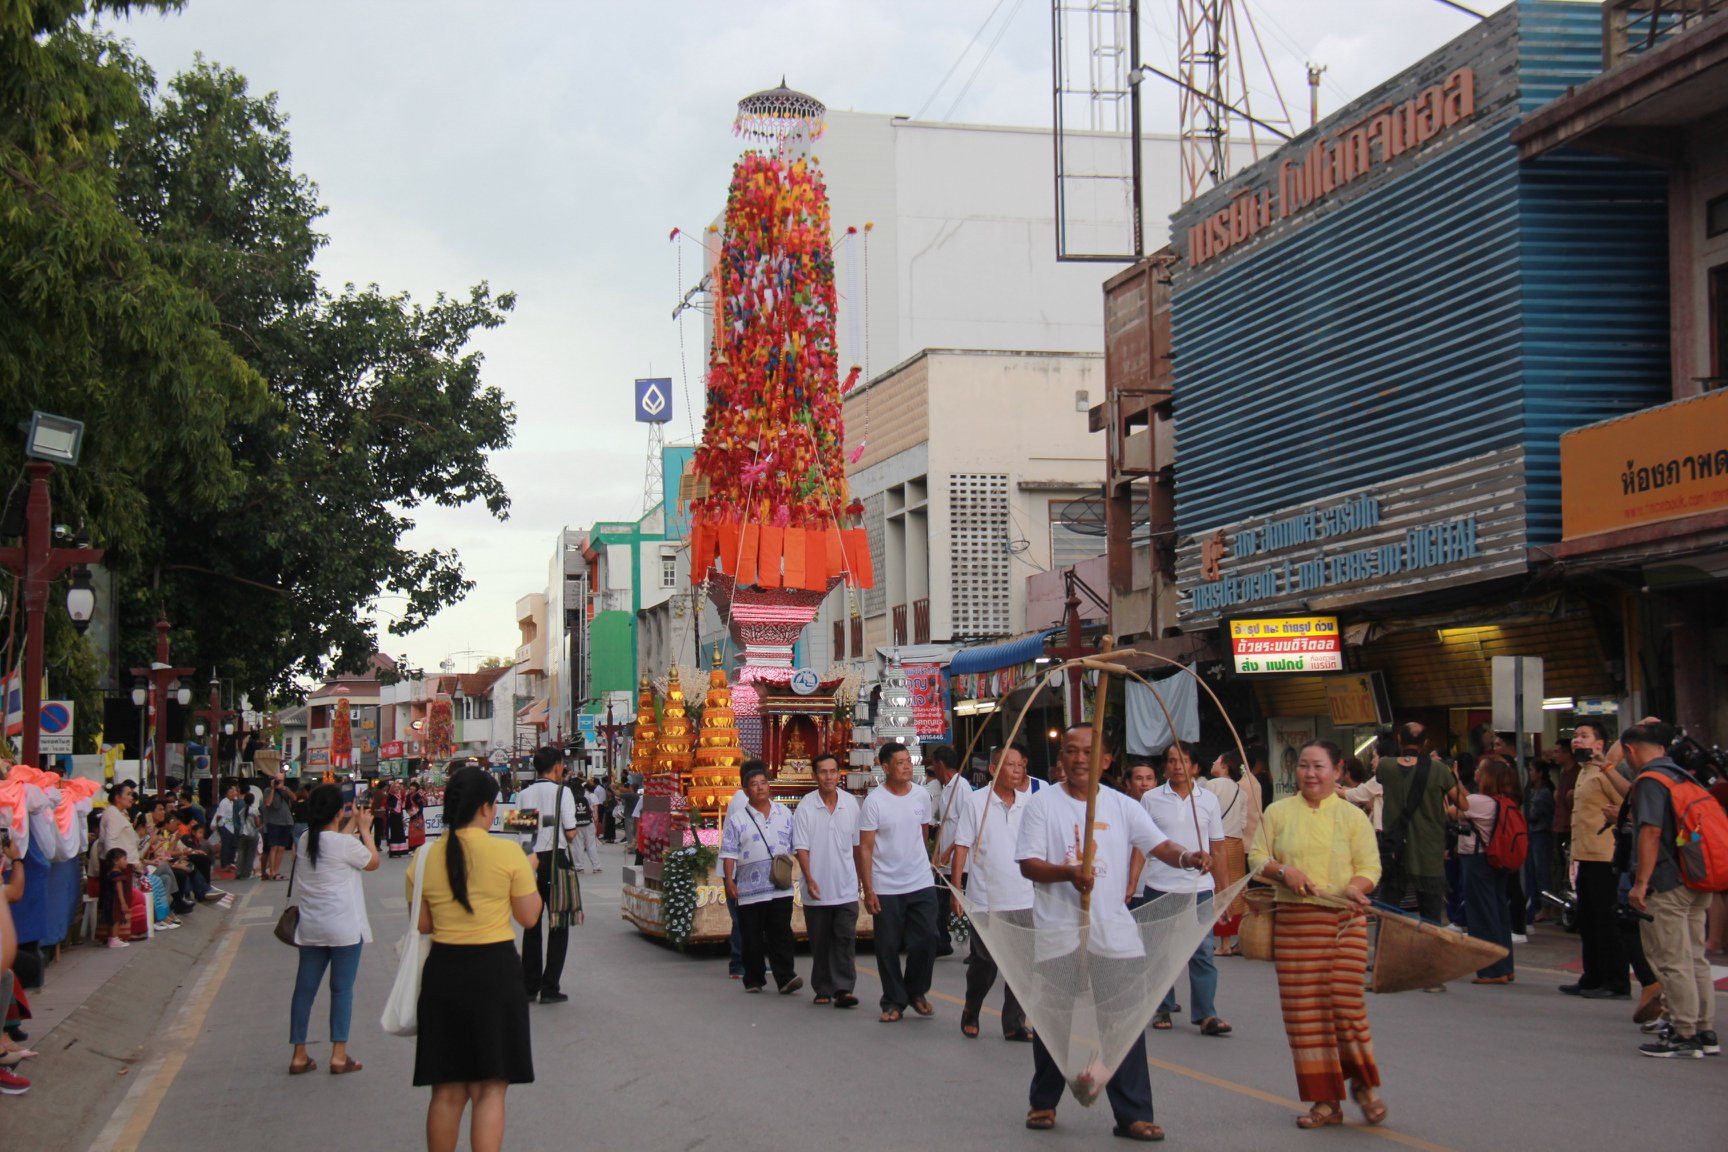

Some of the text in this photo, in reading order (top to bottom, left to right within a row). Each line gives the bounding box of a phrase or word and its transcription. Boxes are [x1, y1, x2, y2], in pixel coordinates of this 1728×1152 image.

[1188, 185, 1271, 267] เนรมิต
[1407, 516, 1482, 571] DIGITAL
[1315, 619, 1334, 632] ด่วน
[1241, 655, 1304, 672] ส่ง แฟกซ์
